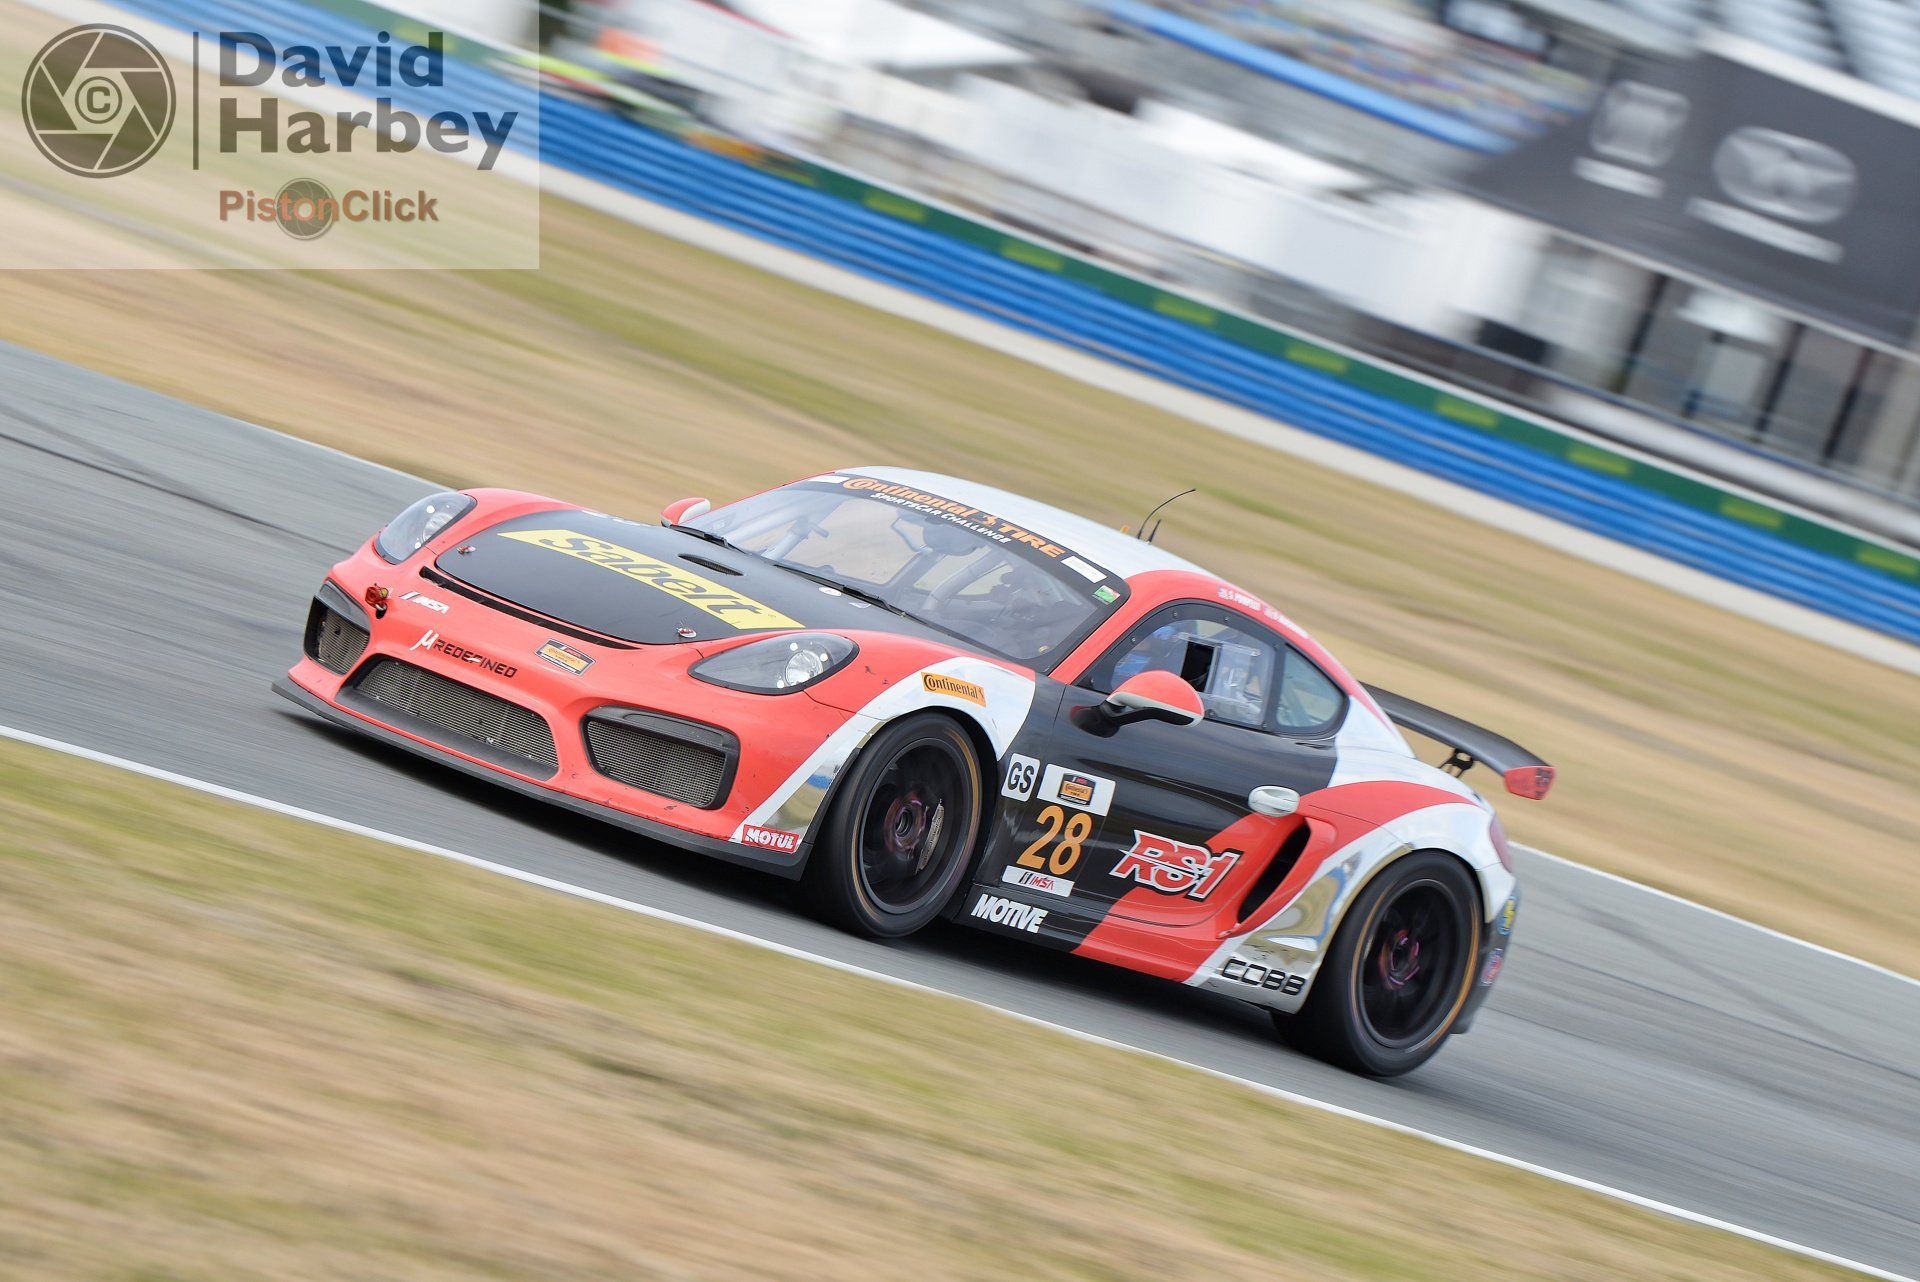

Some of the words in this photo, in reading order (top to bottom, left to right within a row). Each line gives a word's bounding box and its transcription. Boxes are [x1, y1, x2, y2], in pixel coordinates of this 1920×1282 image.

[843, 478, 980, 518] Continental
[998, 523, 1066, 558] TIRE
[539, 537, 764, 615] Sabelt
[924, 674, 979, 700] Continental
[1008, 761, 1035, 794] GS
[745, 828, 795, 850] MOTUL
[1016, 805, 1093, 875] 28
[1029, 875, 1055, 891] IMSA
[970, 893, 1049, 934] MOTIVE
[1222, 958, 1307, 996] COBB
